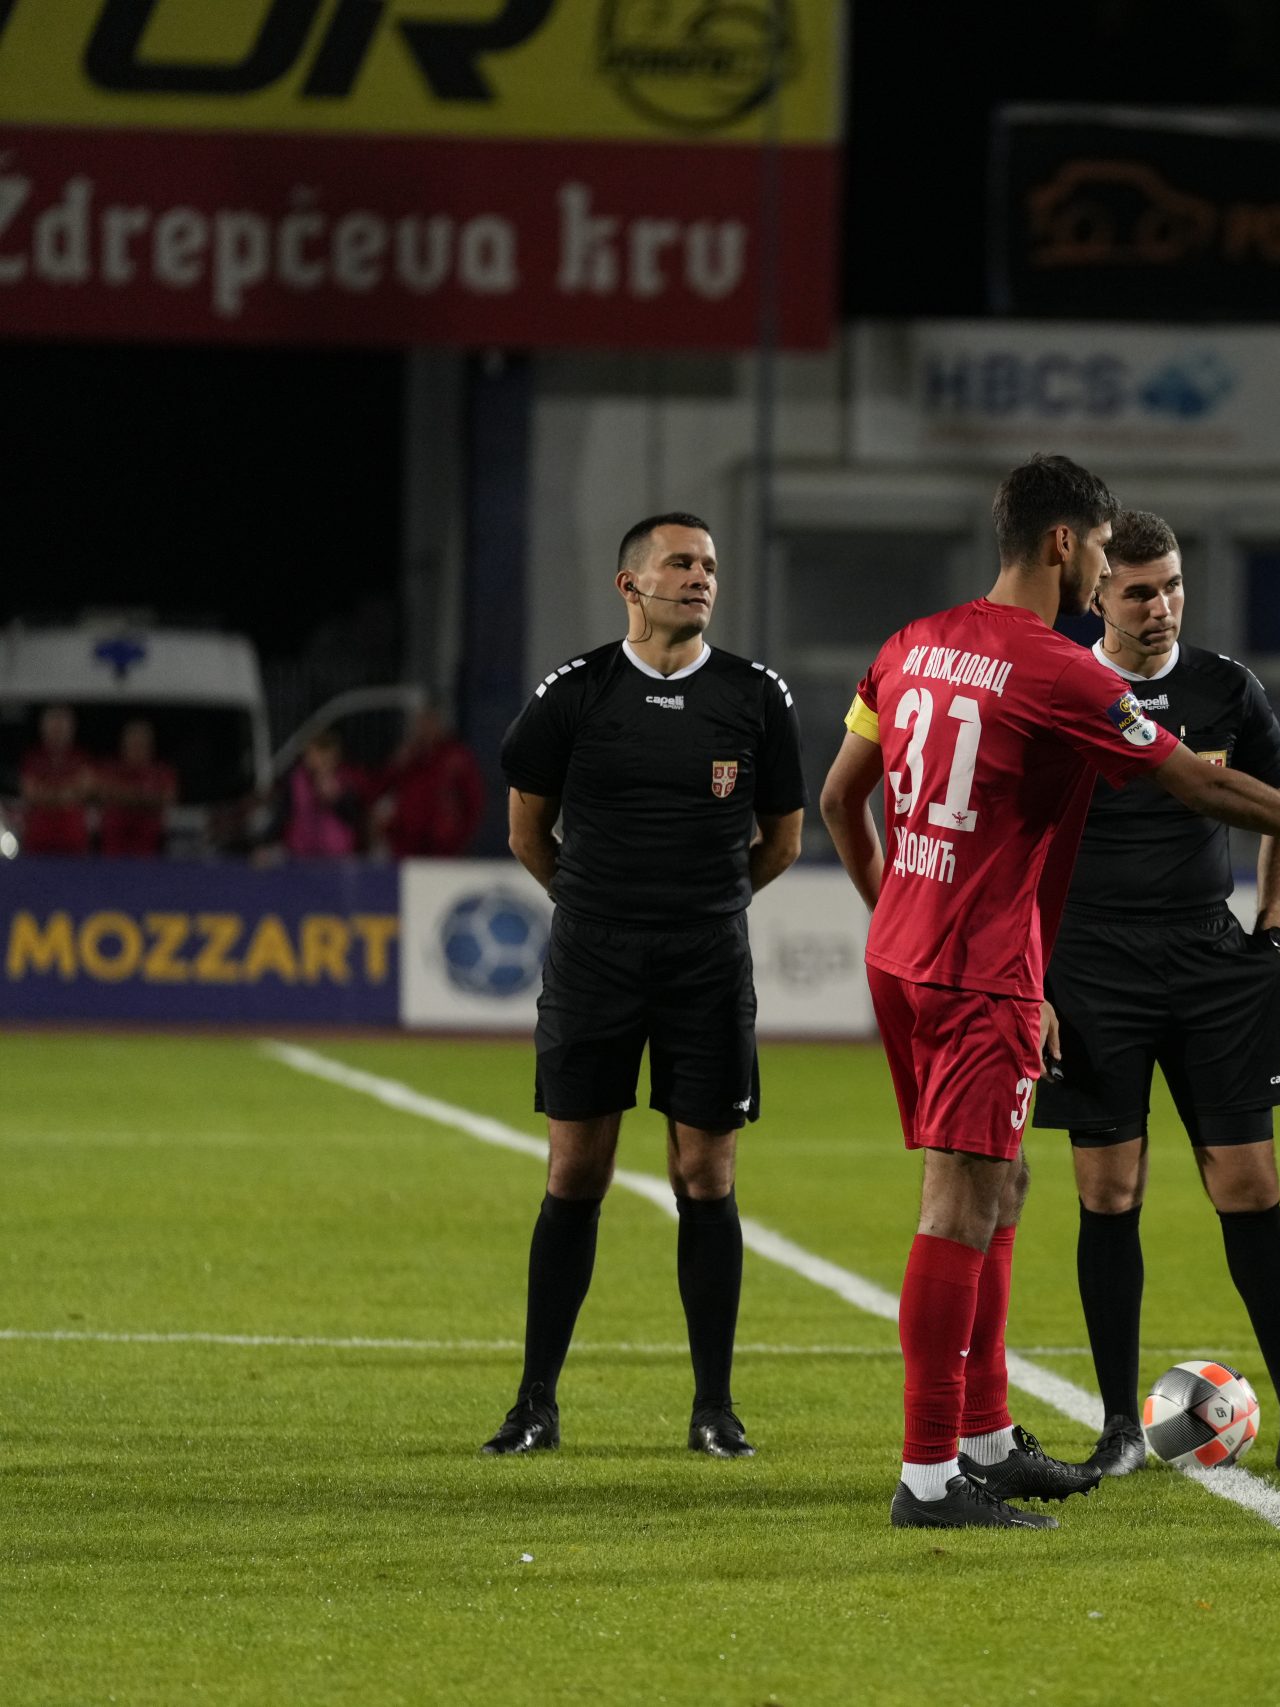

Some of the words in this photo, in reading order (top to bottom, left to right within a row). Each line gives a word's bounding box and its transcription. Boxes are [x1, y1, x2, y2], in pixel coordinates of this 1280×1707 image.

[925, 351, 1129, 419] HBCS
[645, 695, 684, 707] capelli
[903, 645, 930, 676] ФК
[923, 647, 1013, 697] ВОЖДОВАЦ
[1138, 693, 1169, 711] apelli
[888, 687, 982, 833] 31
[6, 909, 400, 983] MOZZART
